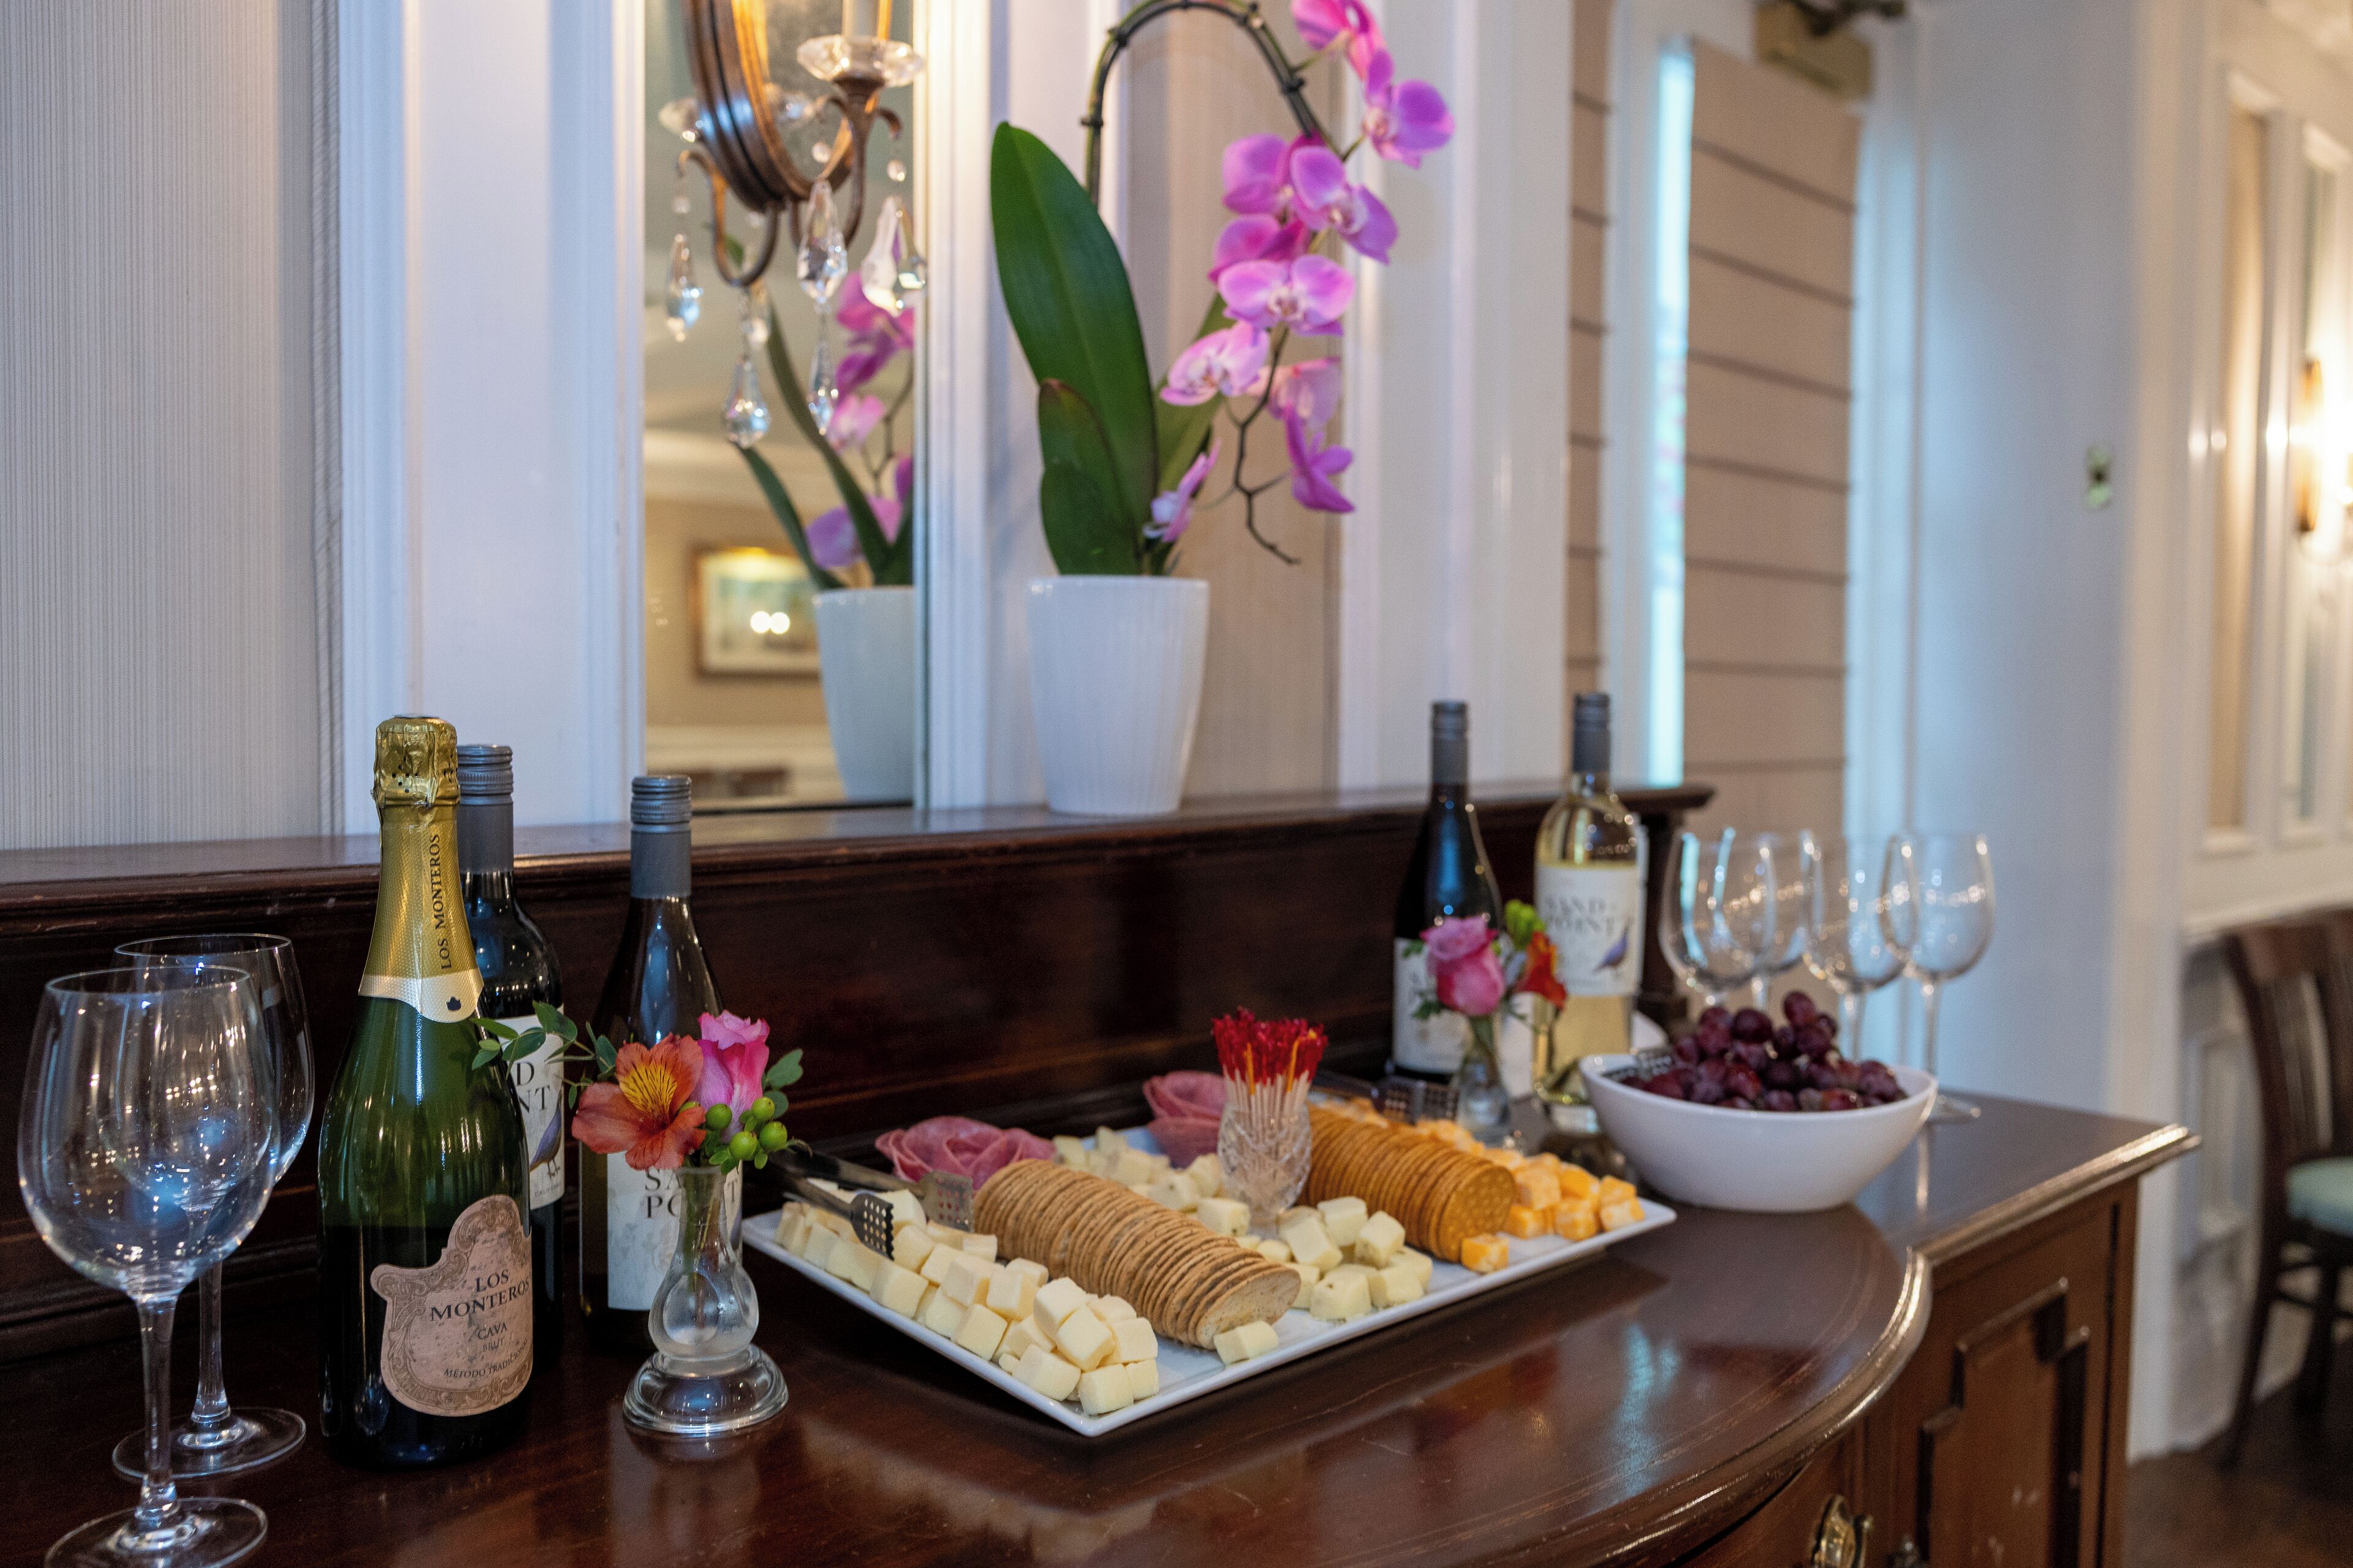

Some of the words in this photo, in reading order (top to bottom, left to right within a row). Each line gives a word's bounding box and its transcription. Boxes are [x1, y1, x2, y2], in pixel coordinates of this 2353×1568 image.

[429, 834, 446, 930] MONTEROS
[437, 937, 452, 971] LOS
[475, 1268, 510, 1293] LOS
[430, 1276, 529, 1322] MONTEROS
[477, 1322, 507, 1341] CAVA
[482, 1337, 505, 1352] BRUT
